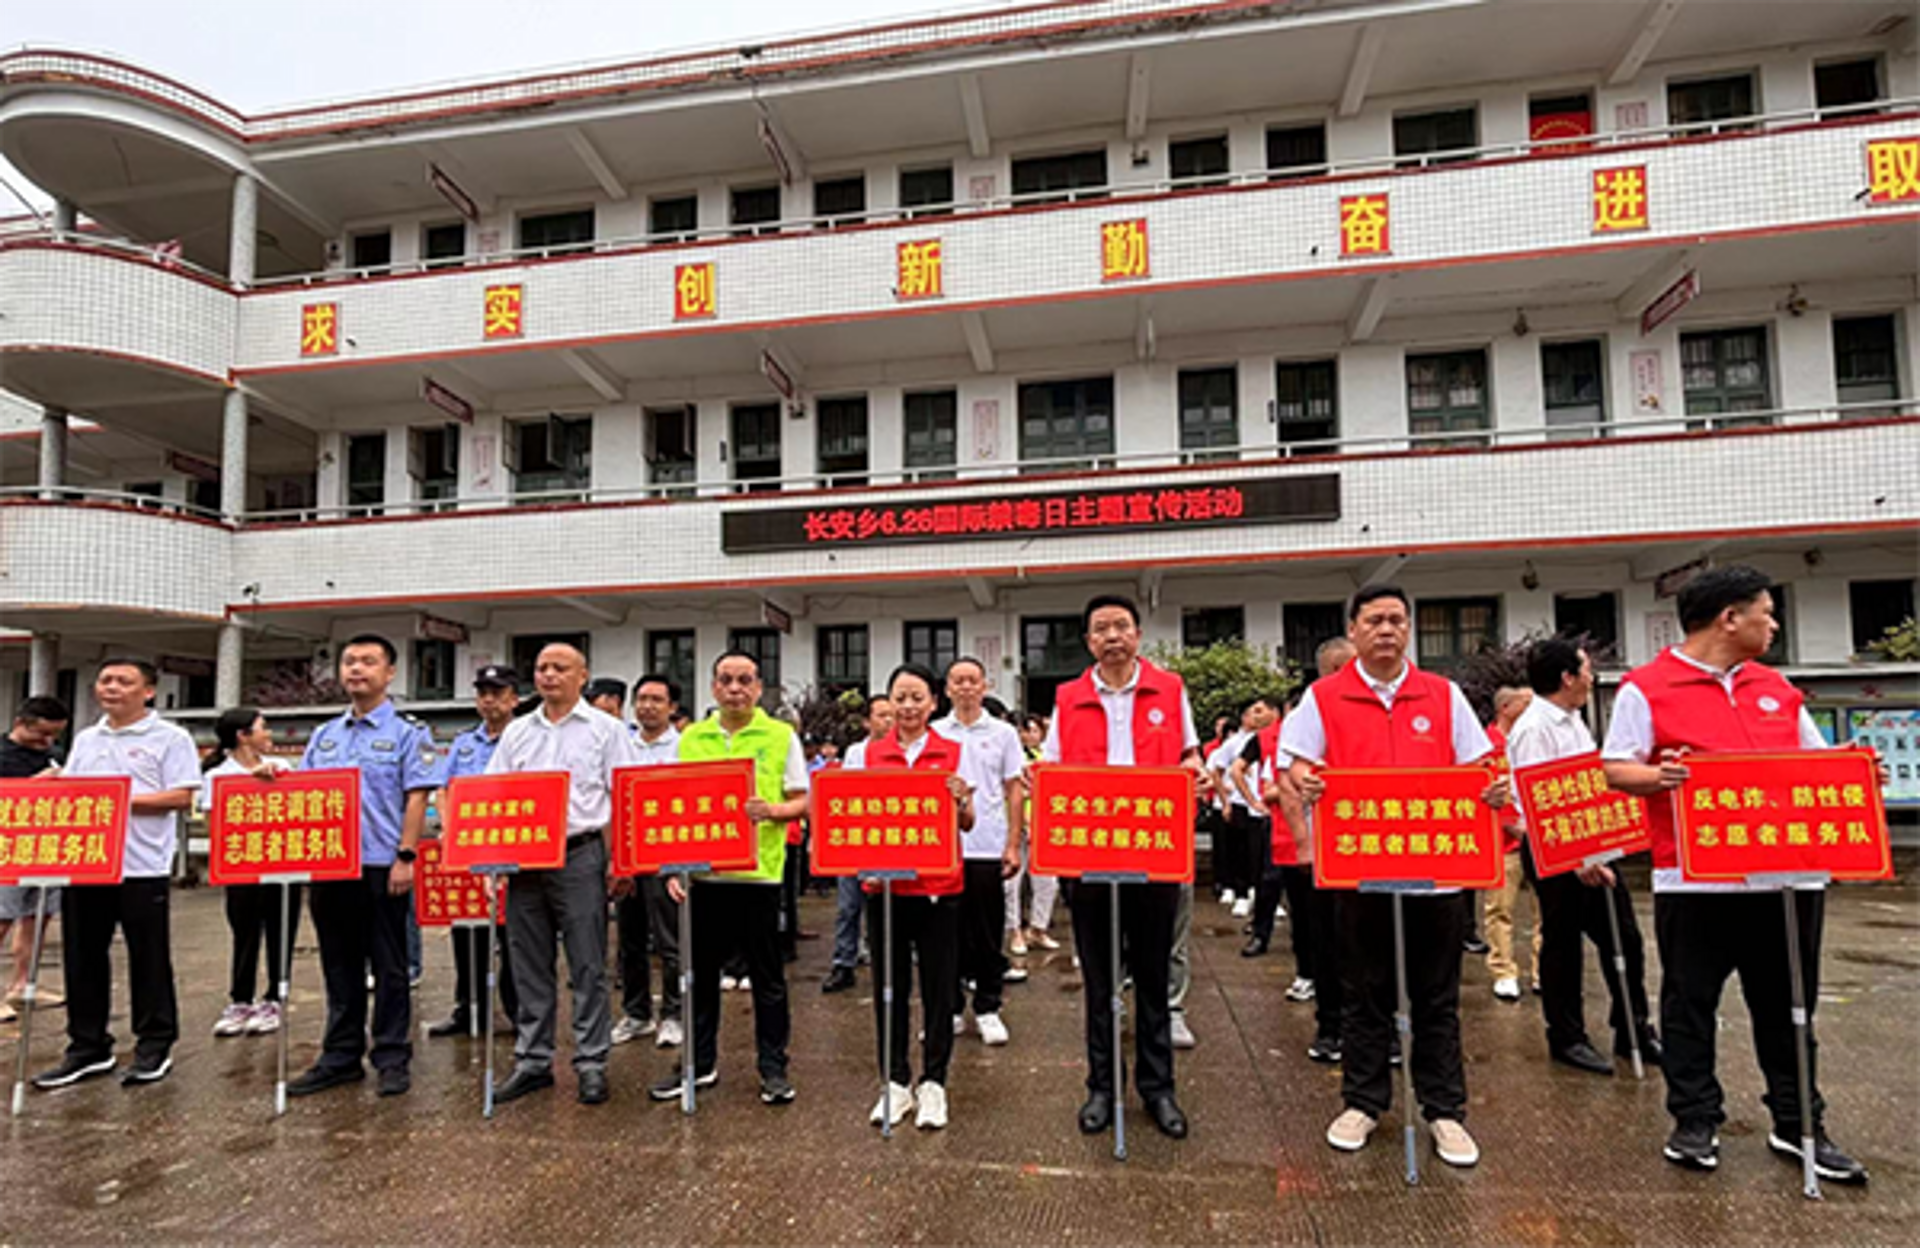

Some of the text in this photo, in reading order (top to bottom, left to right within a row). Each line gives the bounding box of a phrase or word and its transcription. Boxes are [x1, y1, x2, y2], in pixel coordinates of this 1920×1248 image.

[1868, 140, 1920, 202] 取
[1594, 169, 1647, 231] 进
[1341, 196, 1388, 252] 奋
[898, 240, 942, 296] 新
[1102, 222, 1149, 277] 勤
[677, 263, 716, 314] 创
[484, 286, 522, 334] 实
[301, 305, 337, 354] 求
[803, 486, 1243, 541] 长安乡6.26国际禁毒日主题宣传活动
[225, 789, 345, 825] 综治民调宣传
[1050, 794, 1174, 818] 安全生产宣传
[1693, 783, 1867, 811] 反电诈、防性侵
[224, 828, 347, 865] 志愿者服务队
[456, 825, 551, 847] 志愿者服务队
[644, 822, 741, 845] 志愿者服务队
[828, 826, 941, 846] 志愿者服务队
[1049, 827, 1175, 850] 志愿者服务队
[1335, 833, 1480, 856] 志愿者服务队
[1696, 821, 1872, 847] 志愿者服务队
